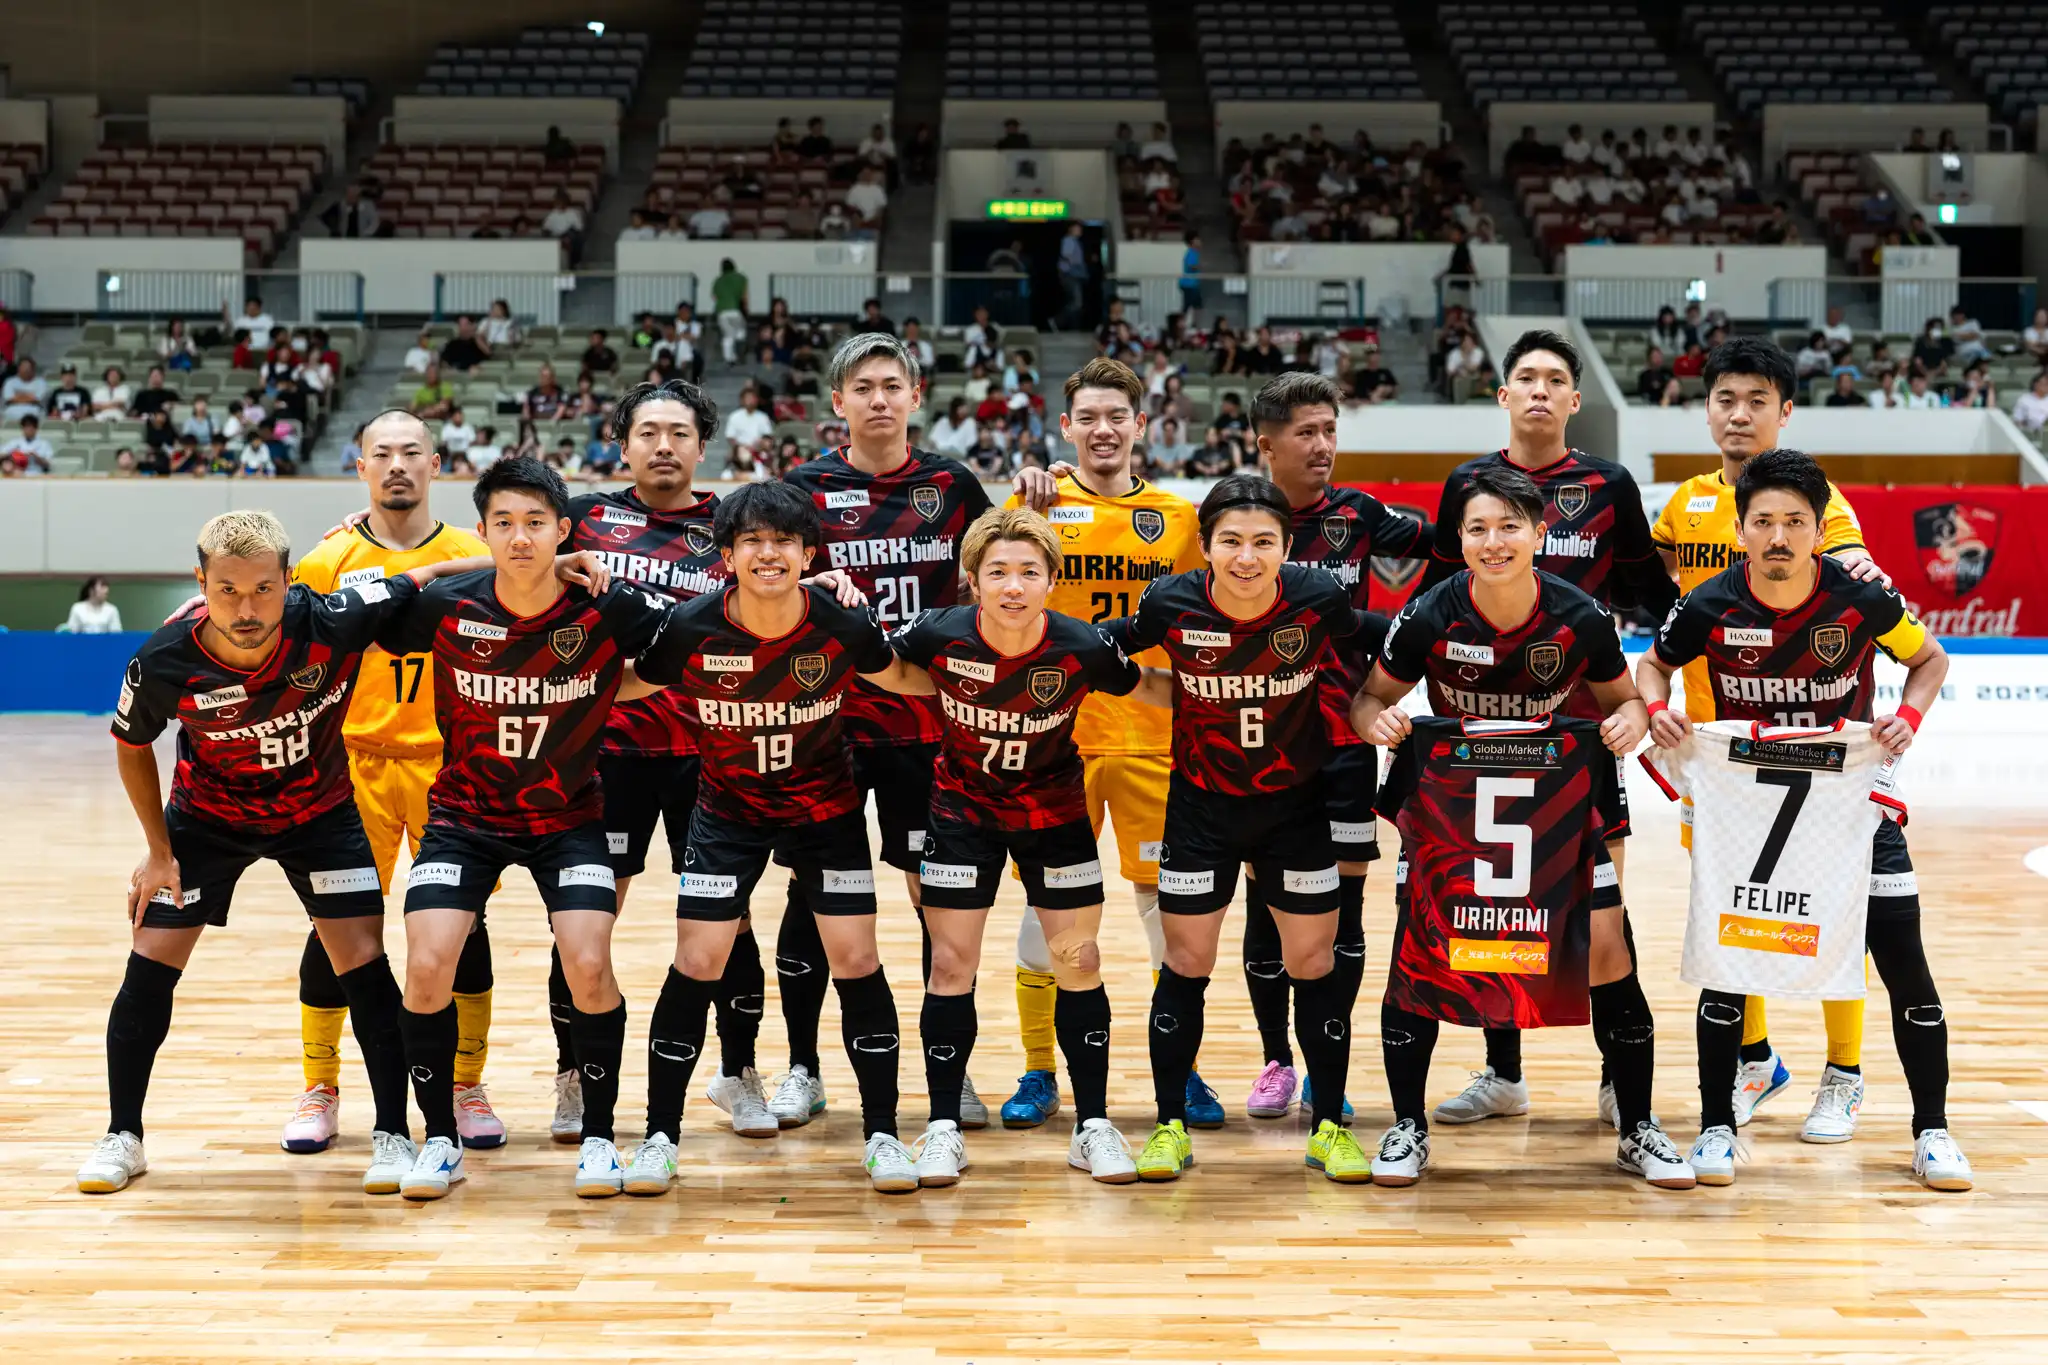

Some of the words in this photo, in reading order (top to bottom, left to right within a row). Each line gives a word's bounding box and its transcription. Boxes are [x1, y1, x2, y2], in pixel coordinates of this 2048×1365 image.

[831, 494, 864, 504] HAZOU
[608, 511, 643, 523] HAZOU
[1053, 511, 1088, 519] HAZOU
[826, 537, 908, 569] BORK
[910, 539, 953, 563] bullet
[1545, 534, 1597, 558] bullet
[344, 571, 379, 585] HAZOU
[1057, 555, 1124, 580] ORK
[875, 575, 920, 621] 20
[1091, 592, 1129, 624] 21
[463, 625, 502, 638] HAZOU
[1188, 632, 1225, 642] HAZOU
[1729, 632, 1766, 642] HAZOU
[709, 658, 747, 667] HAZOU
[1452, 647, 1488, 660] HAZOU
[389, 658, 424, 704] 17
[953, 662, 989, 677] HAZOU
[452, 667, 540, 704] BORK
[543, 673, 597, 704] bullet
[1177, 669, 1265, 699] BORK
[1718, 672, 1807, 703] BORK
[201, 689, 241, 706] HAZOU
[696, 698, 786, 726] BORK
[790, 693, 843, 725] bullet
[1436, 680, 1522, 717] BORK
[939, 688, 1021, 733] BORK
[498, 715, 549, 760] 67
[1240, 707, 1264, 748] 6
[752, 733, 793, 774] 19
[979, 736, 1027, 774] 78
[1473, 743, 1506, 755] Global
[1508, 744, 1542, 756] Market
[1754, 741, 1787, 755] Global
[1789, 745, 1825, 759] Market
[1474, 777, 1535, 897] 5
[1748, 767, 1812, 884] 7
[444, 869, 457, 877] VIE
[926, 868, 945, 876] C'EST
[1163, 876, 1181, 884] C'EST
[1733, 885, 1811, 916] FELIPE
[1454, 906, 1548, 932] URAKAMI
